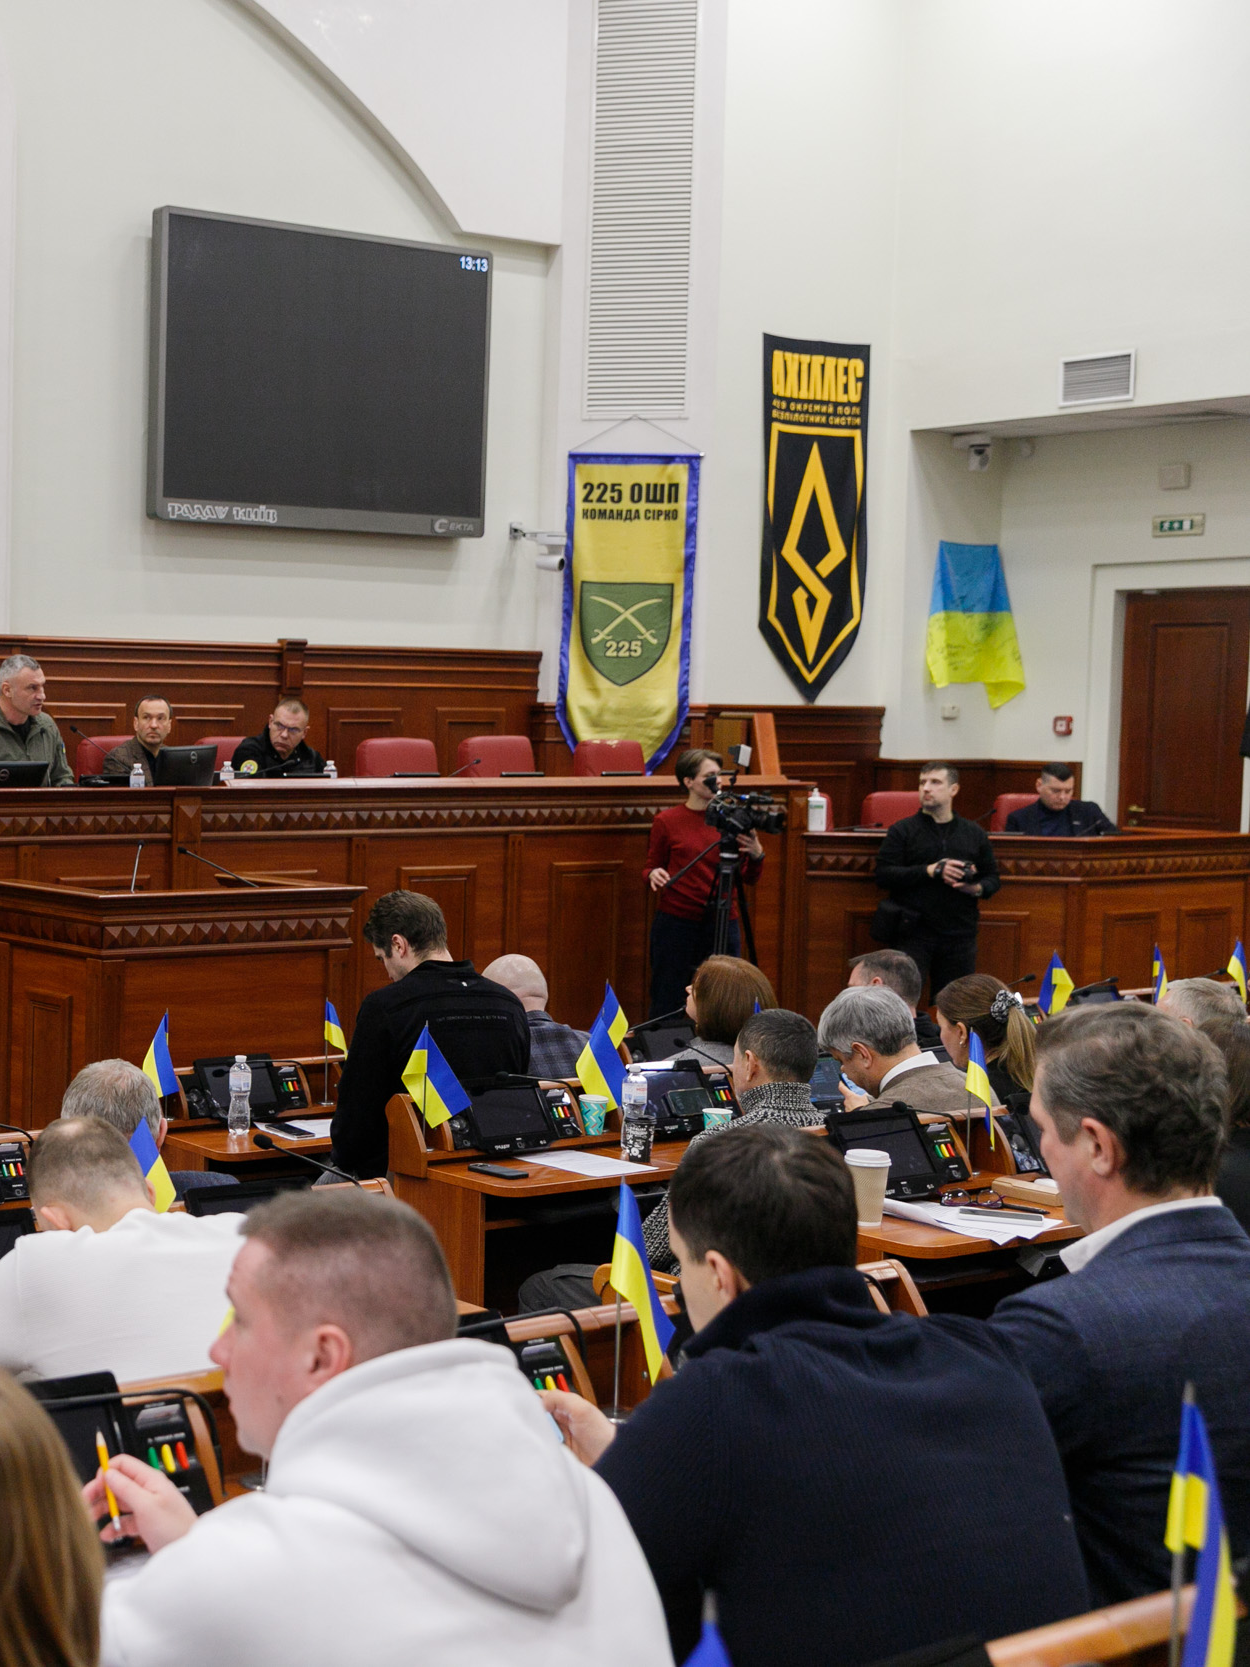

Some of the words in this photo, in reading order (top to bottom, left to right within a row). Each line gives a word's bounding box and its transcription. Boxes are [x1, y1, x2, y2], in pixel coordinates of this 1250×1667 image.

[459, 255, 489, 272] 13:13
[772, 349, 865, 404] АХІЛЛЕС
[789, 401, 834, 415] ОКРЕМИЙ
[582, 482, 623, 504] 225
[630, 482, 680, 504] ОШП
[582, 508, 641, 523] КОМАНДА
[644, 508, 679, 521] СІРКО
[605, 640, 643, 658] 225
